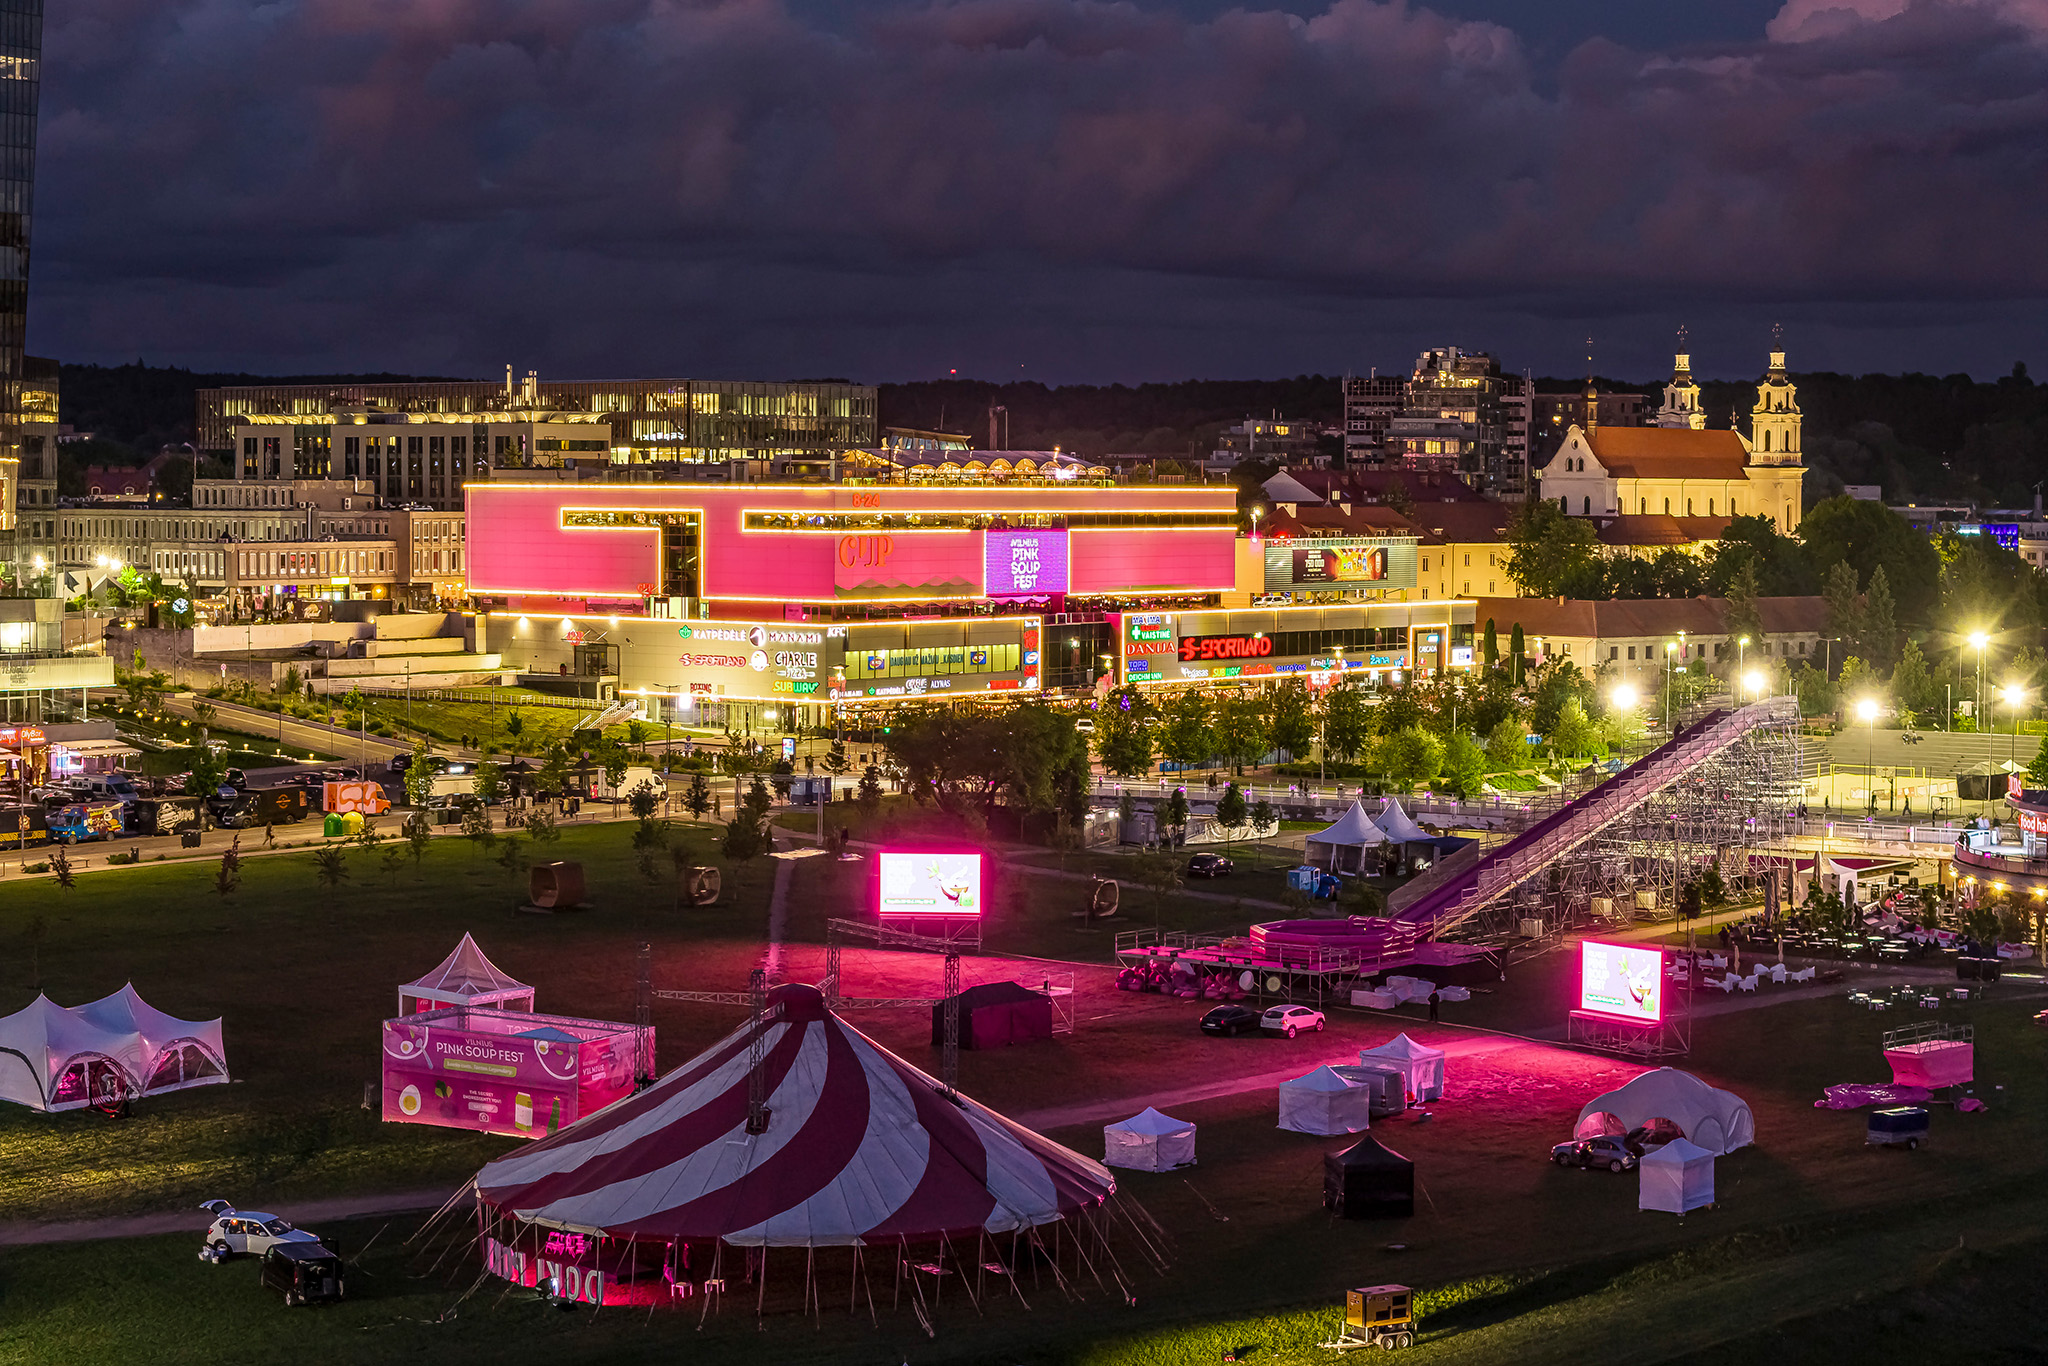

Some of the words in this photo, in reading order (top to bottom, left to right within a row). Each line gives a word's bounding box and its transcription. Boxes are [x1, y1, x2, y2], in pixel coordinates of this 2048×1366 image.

[852, 493, 880, 507] 8-24
[1010, 538, 1039, 547] VILNIUS
[839, 535, 894, 568] CUP
[1012, 547, 1039, 560] PINK
[1011, 561, 1040, 575] SOUP
[1013, 575, 1038, 589] FEST
[1132, 615, 1161, 625] MAXIMA
[693, 629, 747, 642] KATPĖDĖLĖ
[769, 632, 821, 644] MANAMI
[827, 627, 846, 638] KFC
[1141, 628, 1171, 640] VAISTINĖ
[1126, 642, 1176, 656] DANIJA
[1201, 637, 1272, 659] SPORTLAND
[694, 655, 747, 668] SPORTLAND
[775, 651, 818, 668] CHARLIE
[890, 656, 911, 667] DAUGAU
[1212, 666, 1241, 678] SUBWAY
[690, 683, 712, 693] BOXING
[773, 681, 820, 694] SUBWAY
[2020, 814, 2036, 830] food
[465, 1038, 493, 1048] VILNIUS
[436, 1042, 464, 1056] PINK
[465, 1046, 497, 1059] SOUP
[499, 1050, 525, 1063] FEST
